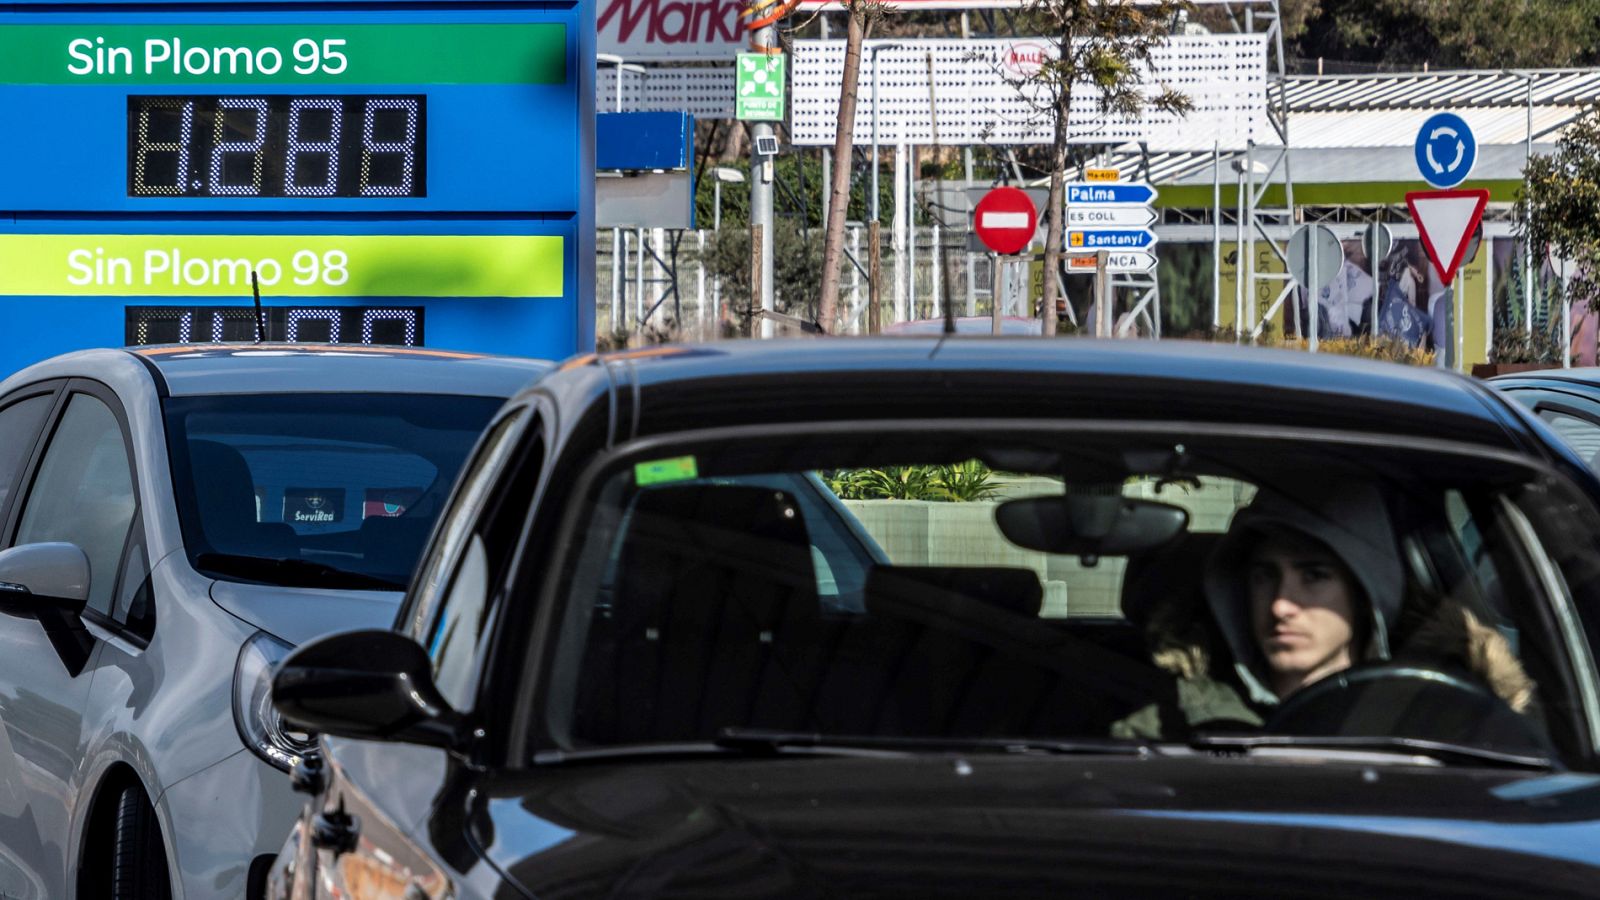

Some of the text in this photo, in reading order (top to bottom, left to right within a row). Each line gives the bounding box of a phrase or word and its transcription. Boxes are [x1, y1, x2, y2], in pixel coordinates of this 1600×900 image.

[67, 36, 348, 75] Sin Plomo 95
[1070, 187, 1115, 201] Palma
[1070, 211, 1116, 221] ES COLL
[1087, 232, 1144, 246] Santanyí
[67, 247, 349, 286] Sin Plomo 98
[294, 509, 335, 522] ServiRed
